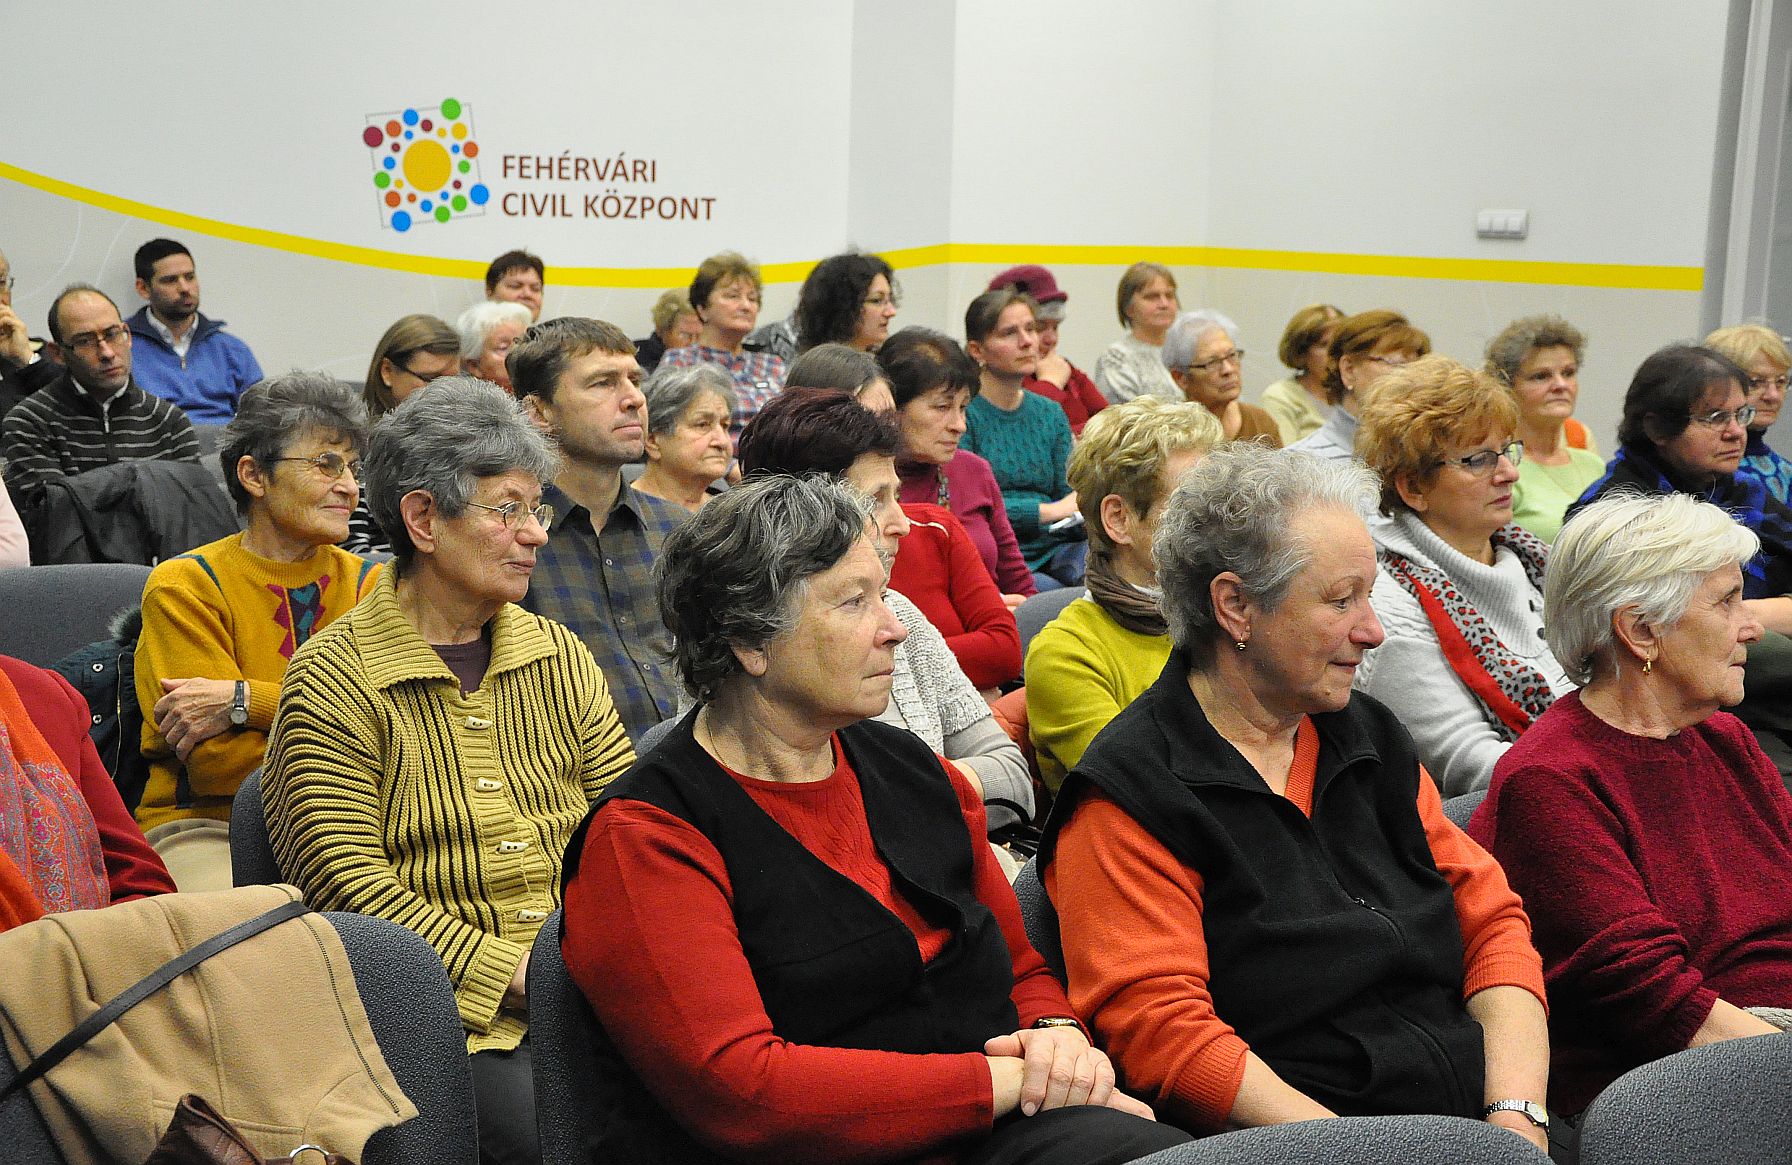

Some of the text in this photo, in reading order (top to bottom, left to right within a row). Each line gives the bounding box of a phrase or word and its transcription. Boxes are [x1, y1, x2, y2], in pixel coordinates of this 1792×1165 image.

[503, 150, 656, 183] FEHÉRVÁRI
[502, 189, 716, 220] CIVIL KÖZPONT
